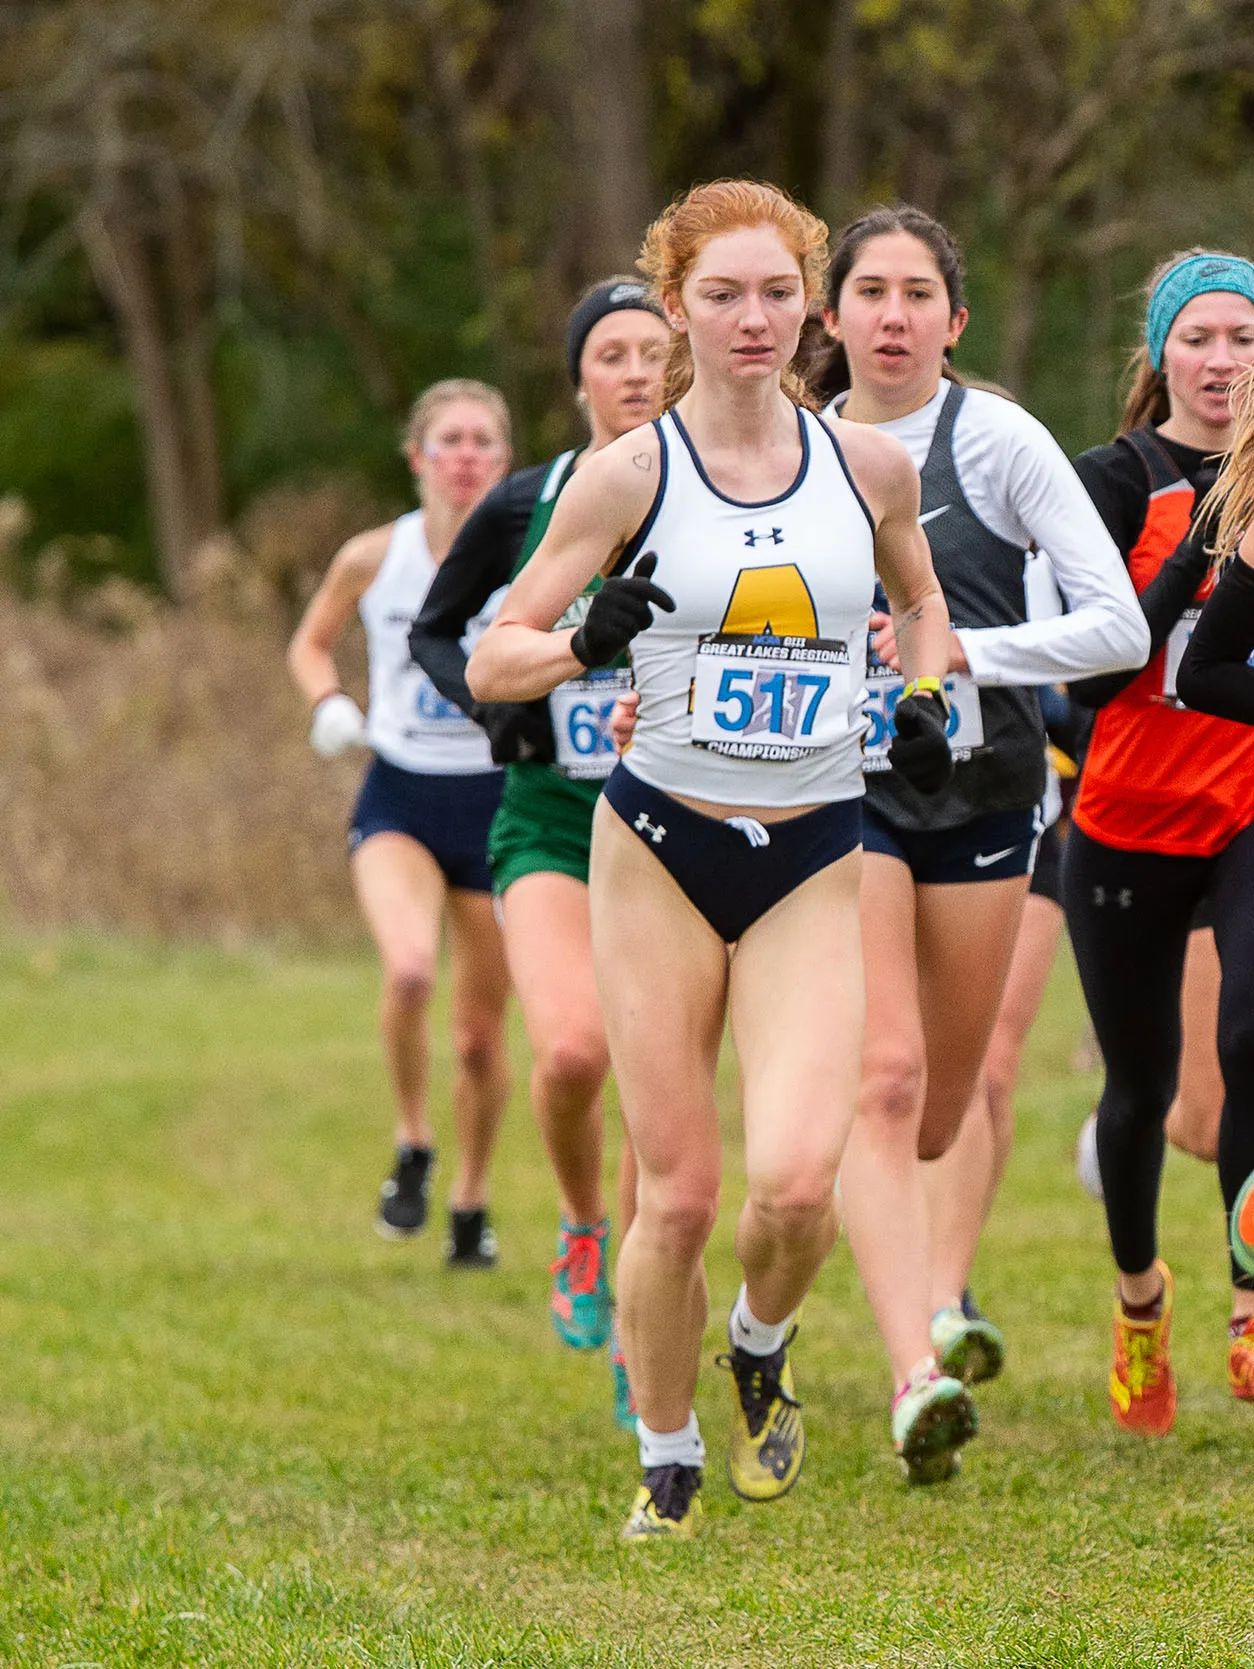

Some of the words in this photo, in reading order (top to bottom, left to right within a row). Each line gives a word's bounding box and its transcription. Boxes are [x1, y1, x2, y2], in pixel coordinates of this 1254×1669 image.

[700, 643, 746, 656] GREAT
[746, 646, 789, 658] LAKES
[790, 649, 851, 663] REGIONAL
[714, 668, 831, 736] 517
[707, 741, 814, 761] CHAMPIONSH
